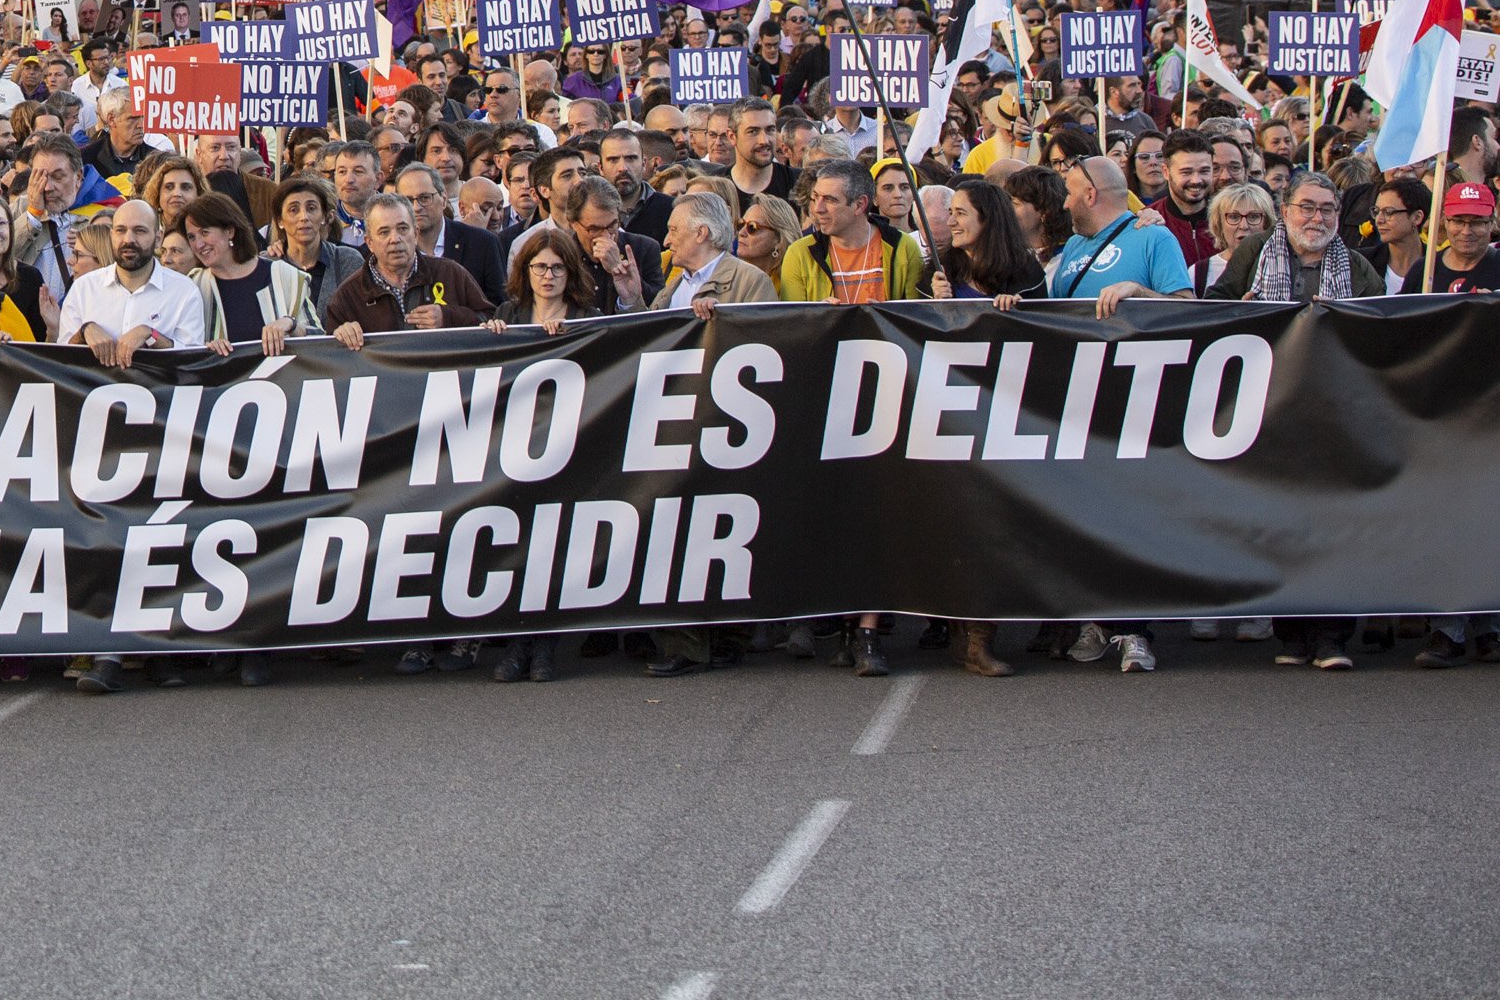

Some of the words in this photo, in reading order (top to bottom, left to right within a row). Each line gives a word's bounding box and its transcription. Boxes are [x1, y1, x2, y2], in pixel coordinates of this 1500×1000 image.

[40, 0, 71, 8] Tamara!
[296, 4, 323, 35] NO
[329, 0, 368, 31] HAY
[486, 0, 512, 24] NO
[211, 26, 238, 53] NO
[243, 25, 284, 53] HAY
[484, 21, 556, 51] JUSTÍCIA
[1070, 17, 1095, 46] NO
[1100, 15, 1137, 45] HAY
[1279, 16, 1307, 44] NO
[1313, 17, 1354, 45] HAY
[295, 31, 371, 61] JUSTÍCIA
[841, 40, 874, 73] NO
[879, 40, 924, 73] HAY
[1067, 44, 1136, 74] JUSTÍCIA
[1274, 45, 1351, 72] JUSTÍCIA
[679, 52, 704, 75] NO
[709, 51, 744, 74] HAY
[150, 66, 176, 95] NO
[243, 65, 272, 94] NO
[279, 65, 322, 95] HAY
[676, 73, 741, 100] JUSTÍCIA
[836, 71, 924, 106] JUSTÍCIA
[148, 95, 237, 131] PASARÁN
[240, 94, 319, 123] JUSTÍCIA
[408, 359, 585, 484] NO
[621, 347, 782, 472] ES
[820, 334, 1275, 461] DELITO
[109, 499, 257, 637] ÉS
[286, 492, 760, 628] DECIDIR
